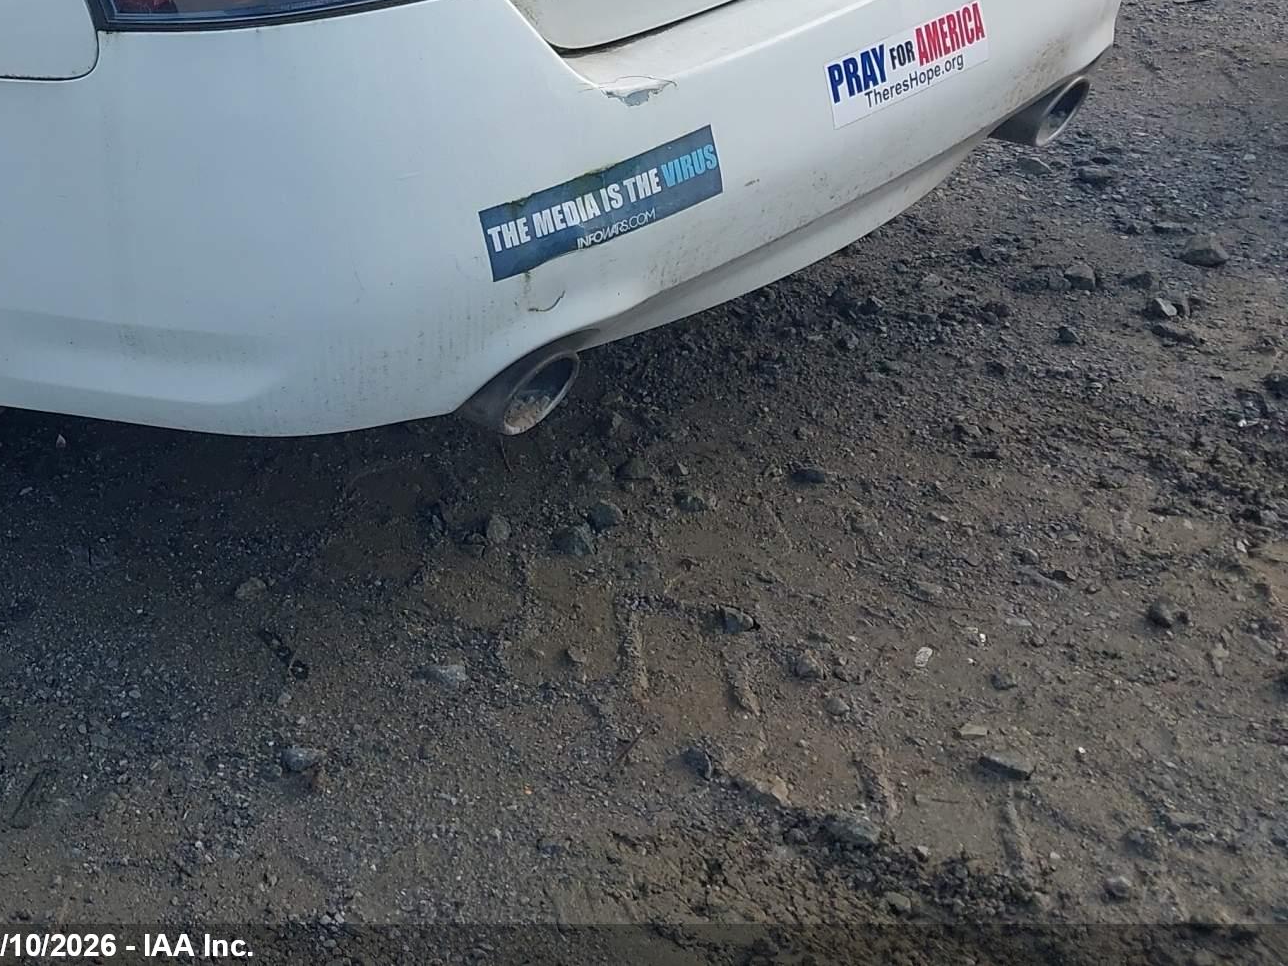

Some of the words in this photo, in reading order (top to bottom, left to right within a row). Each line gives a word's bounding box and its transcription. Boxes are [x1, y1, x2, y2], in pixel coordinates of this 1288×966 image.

[827, 44, 888, 104] PRAY
[889, 40, 916, 70] FOR
[915, 2, 986, 66] AMERICA
[864, 53, 964, 108] TheresHope.org
[487, 217, 530, 253] THE
[532, 192, 601, 239] MEDIA
[600, 184, 623, 213] IS
[622, 168, 662, 203] THE
[661, 144, 718, 188] VIRUS
[576, 208, 657, 250] INFOWARS.COM
